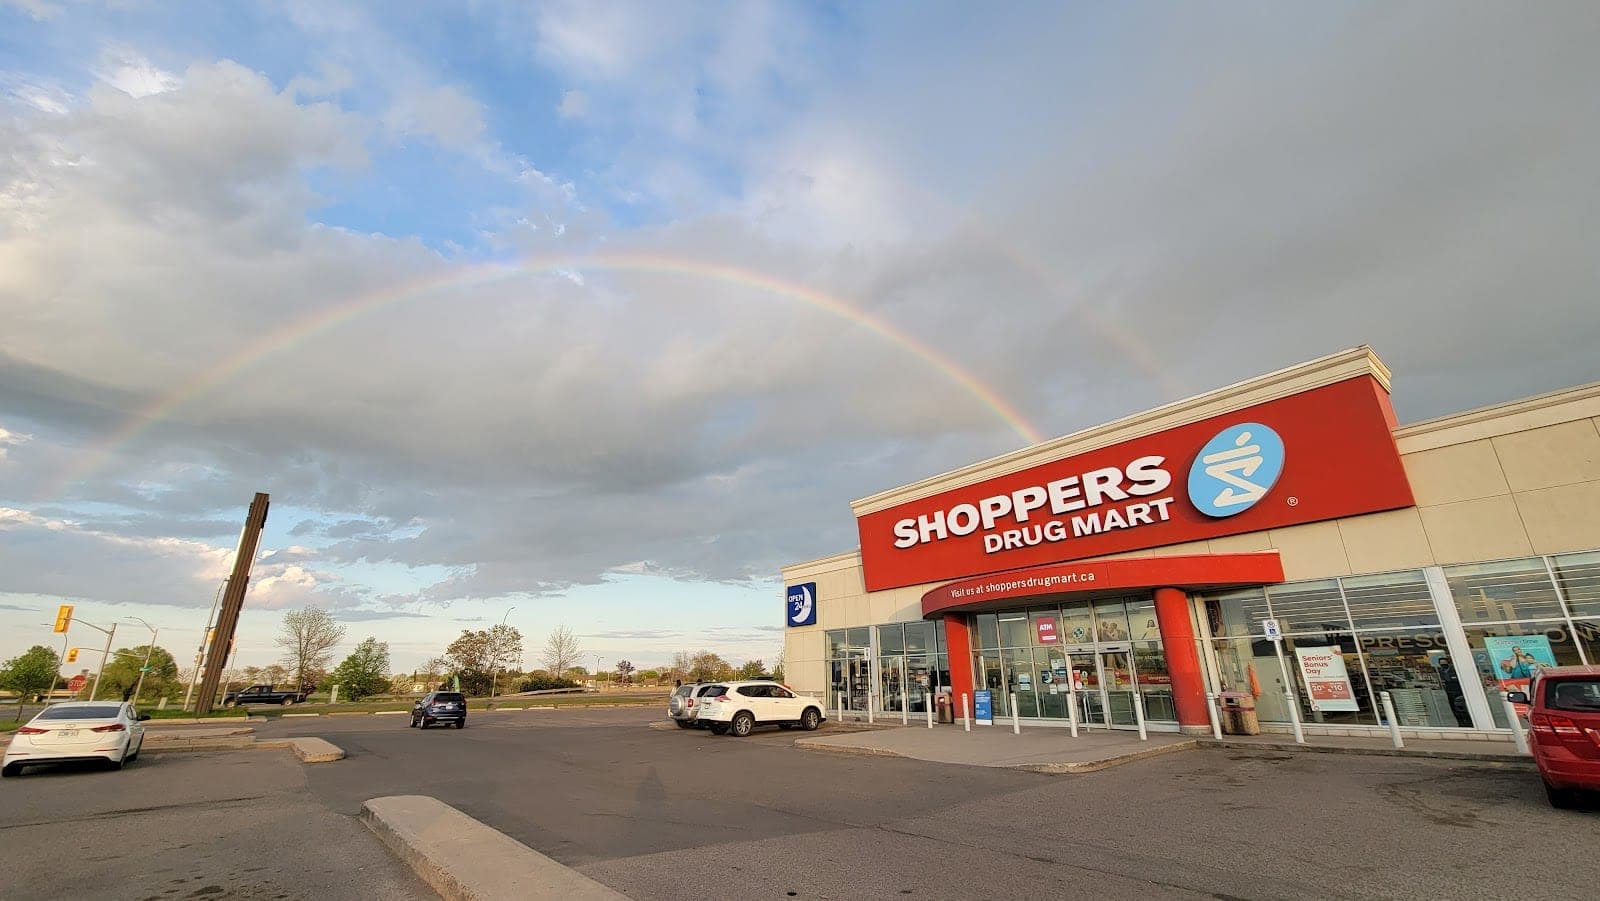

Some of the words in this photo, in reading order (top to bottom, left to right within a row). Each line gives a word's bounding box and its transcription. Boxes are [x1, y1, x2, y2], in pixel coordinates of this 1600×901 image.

[893, 455, 1172, 549] SHOPPERS
[983, 520, 1068, 554] DRUG
[1071, 497, 1174, 538] MART
[950, 589, 965, 599] Visit
[966, 588, 975, 596] us
[975, 585, 984, 594] at
[985, 572, 1095, 593] shoppersdrugmart.ca
[788, 594, 804, 603] OPEN
[794, 601, 803, 611] 24
[1039, 623, 1053, 631] ATM
[70, 679, 86, 688] STOP
